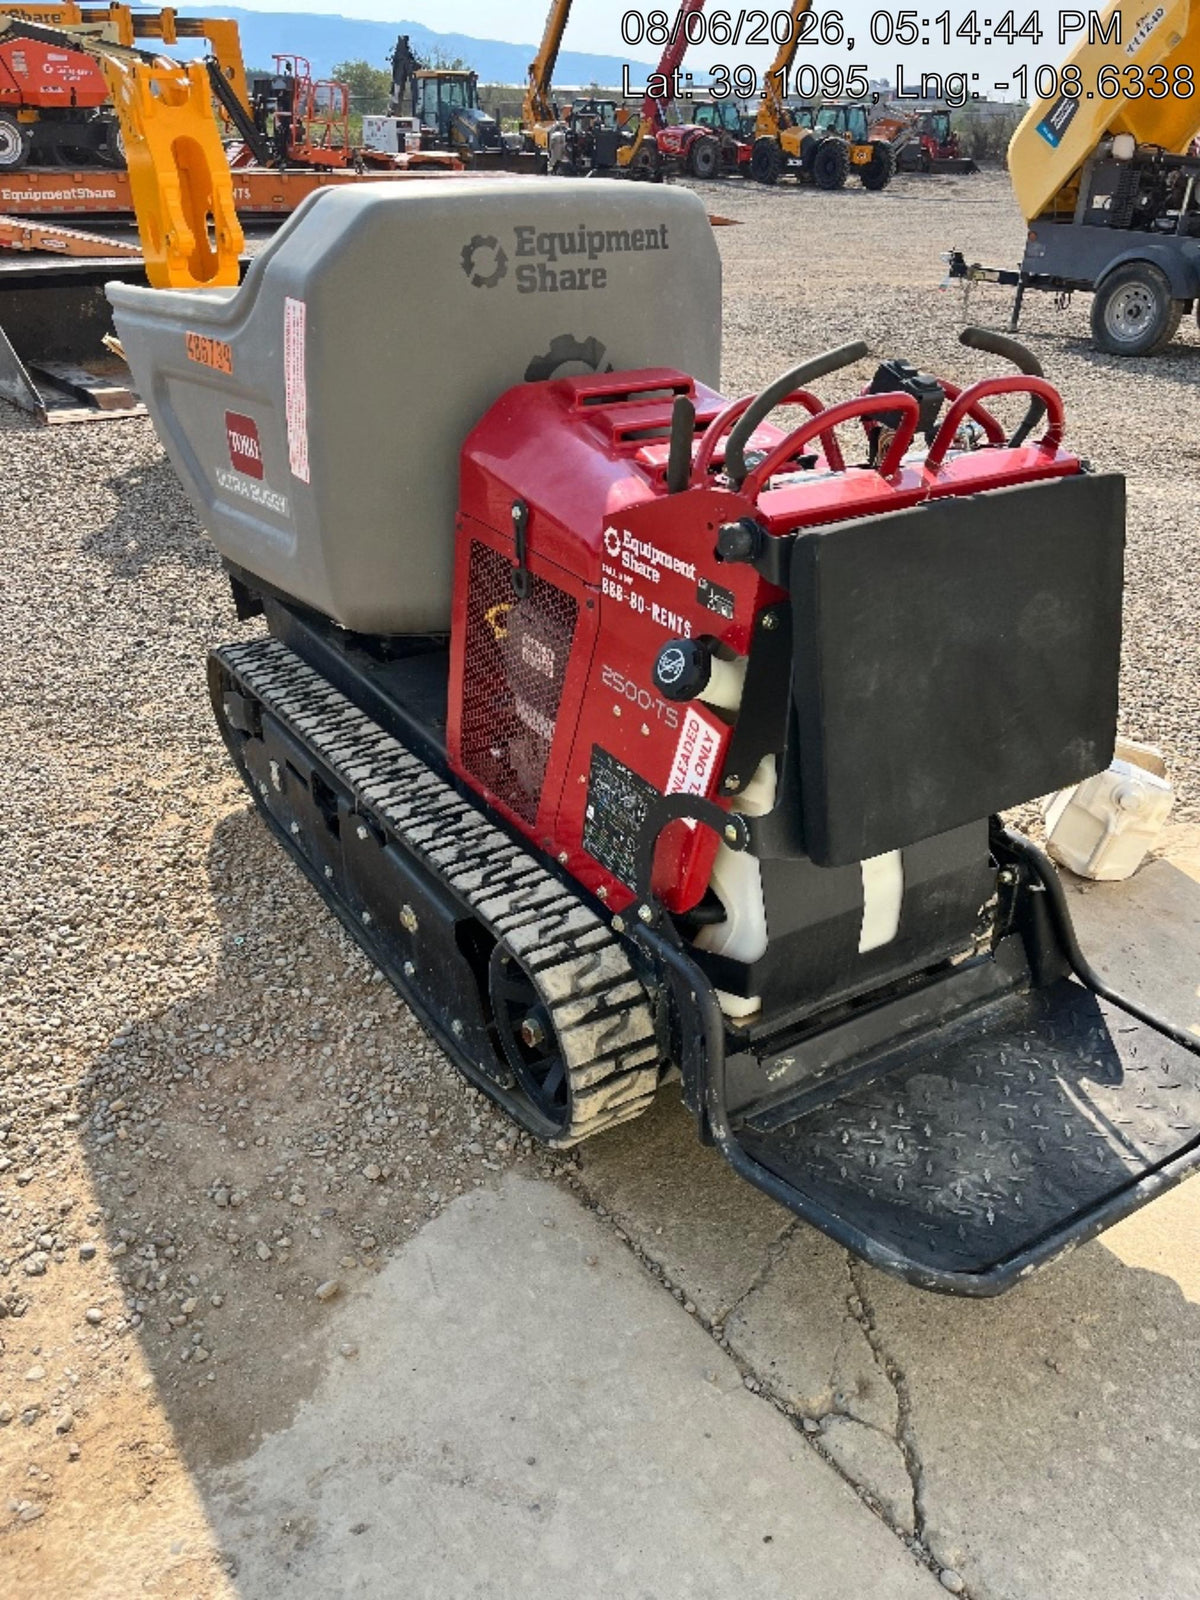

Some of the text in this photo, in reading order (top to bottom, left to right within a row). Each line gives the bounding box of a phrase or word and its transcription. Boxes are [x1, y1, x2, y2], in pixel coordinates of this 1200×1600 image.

[513, 224, 669, 261] Equipment
[515, 263, 607, 293] Share
[622, 529, 696, 582] Equipment
[622, 551, 660, 583] Share
[602, 577, 692, 638] 888-80-RENTS
[671, 719, 699, 793] NLEADED
[695, 731, 714, 777] ONLY
